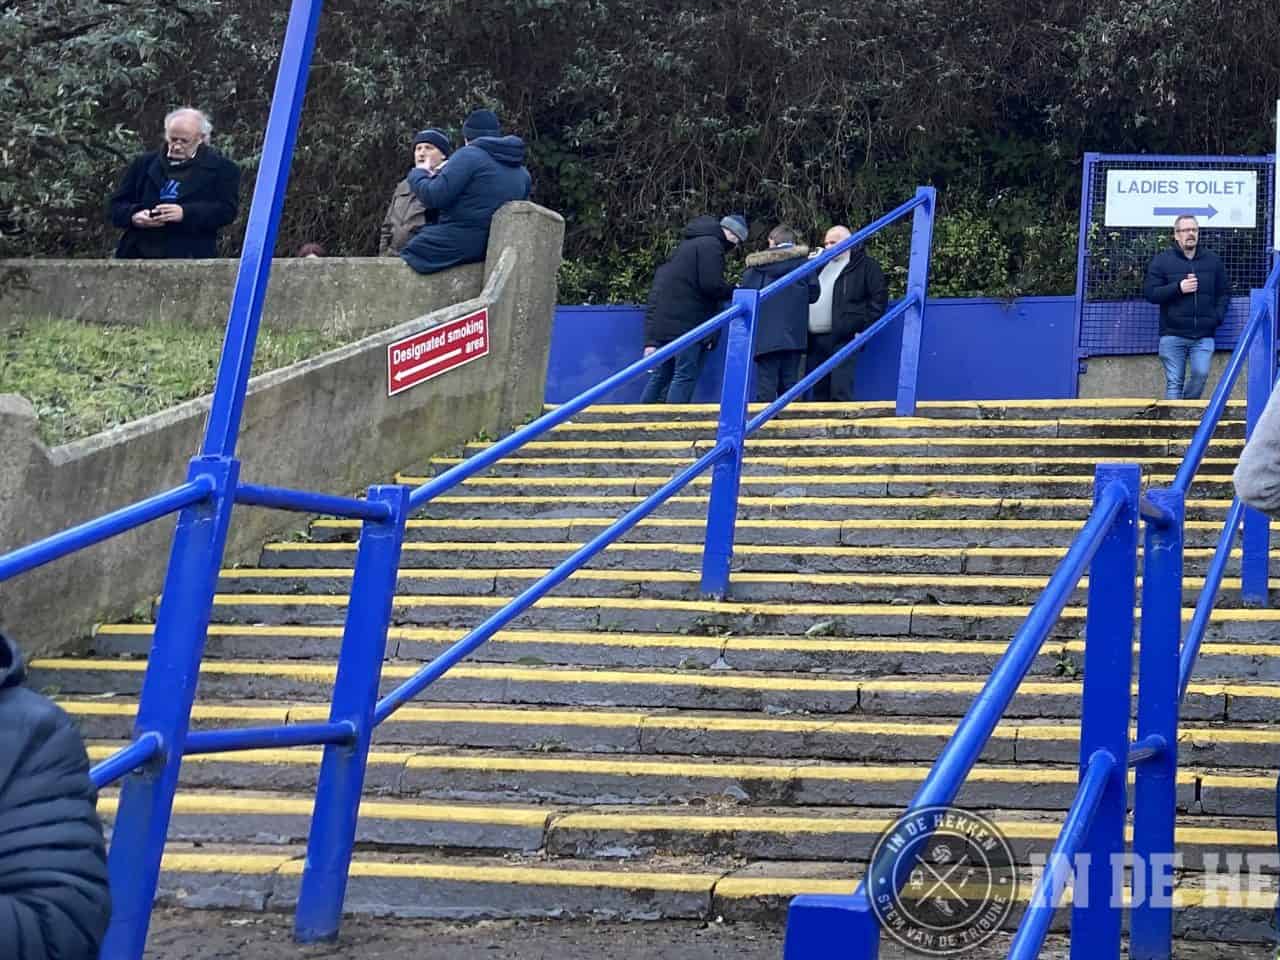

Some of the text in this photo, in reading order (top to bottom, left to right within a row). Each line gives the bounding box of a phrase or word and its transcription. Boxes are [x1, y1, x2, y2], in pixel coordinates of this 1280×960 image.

[1117, 180, 1245, 195] LADIES TOILET
[393, 319, 484, 365] Designated smoking
[465, 337, 485, 354] area
